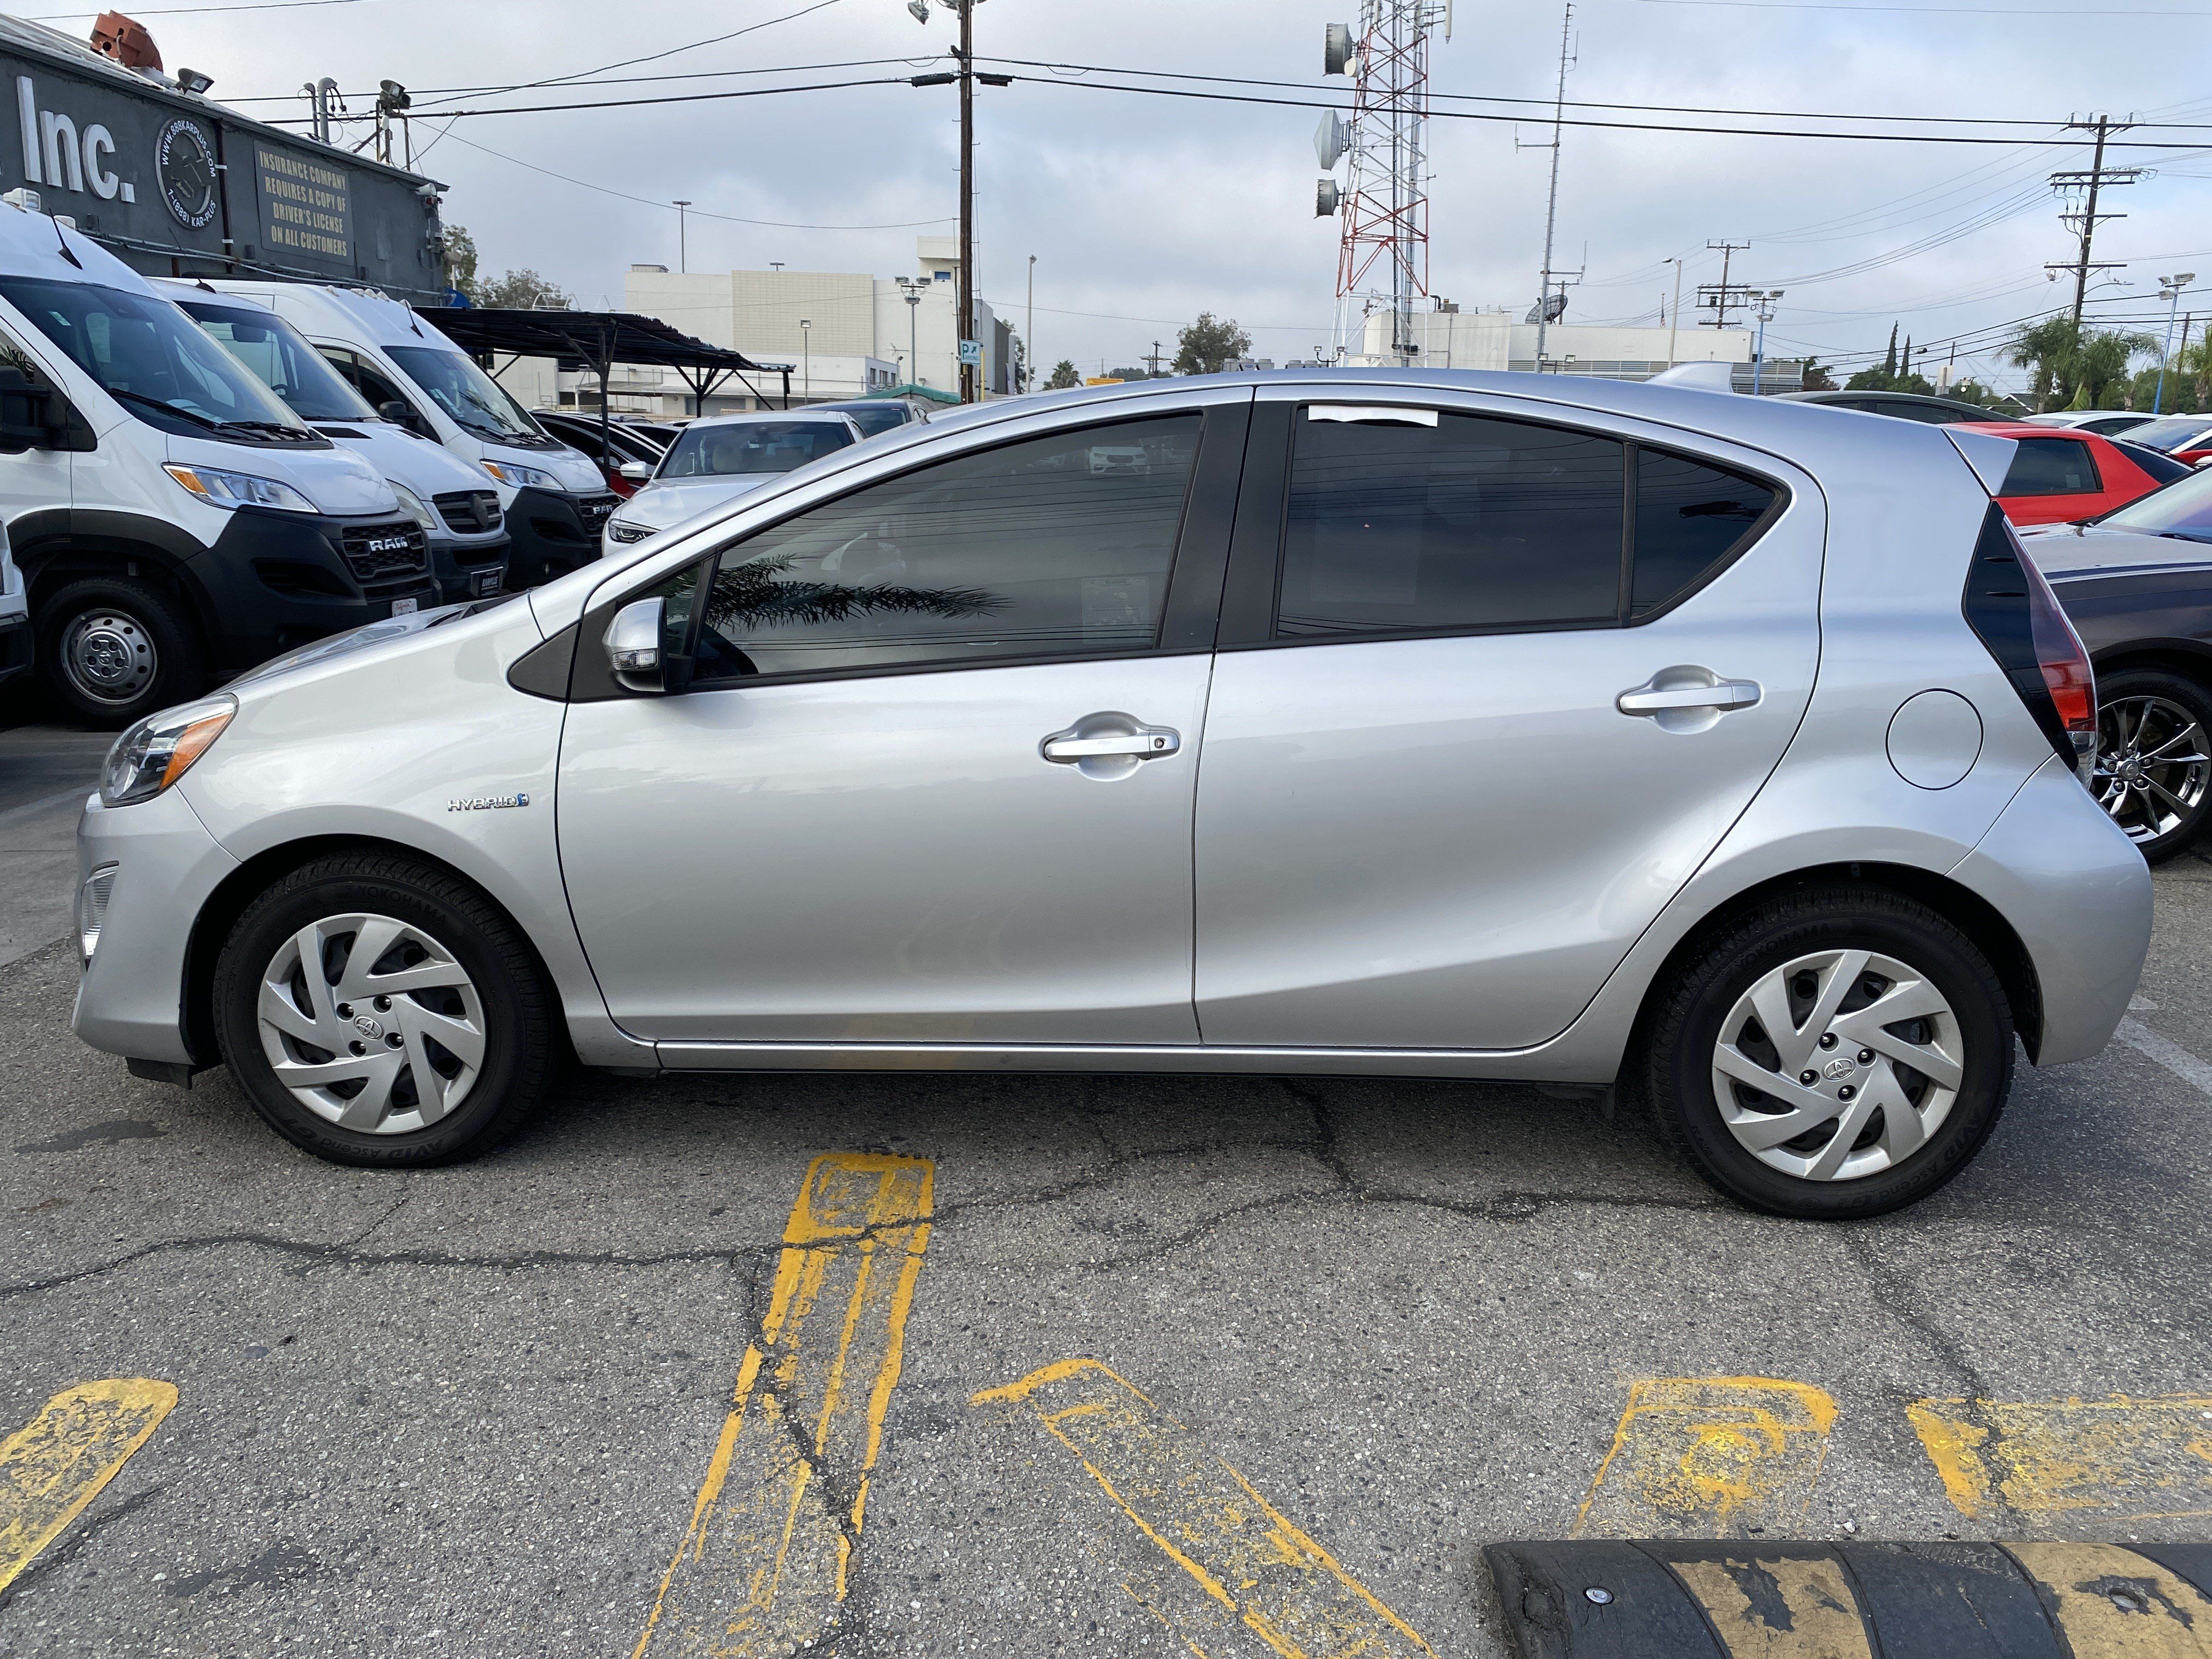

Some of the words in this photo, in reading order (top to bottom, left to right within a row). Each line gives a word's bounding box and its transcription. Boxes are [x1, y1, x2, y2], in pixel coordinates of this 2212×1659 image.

[16, 75, 136, 203] Inc.
[162, 120, 216, 177] WWW.888KARPLUS.COM
[259, 150, 308, 180] INSURANCE
[309, 166, 346, 190] COMPANY
[265, 176, 307, 202] REQUIRES
[308, 188, 314, 204] A
[315, 190, 335, 210] COPY
[337, 196, 346, 212] OF
[273, 202, 311, 227] DRIVER'S
[313, 212, 343, 234] LICENSE
[271, 225, 283, 243] ON
[285, 229, 299, 247] ALL
[300, 232, 347, 257] CUSTOMERS
[369, 537, 408, 551] RAM
[447, 796, 517, 811] HYBRID
[358, 885, 447, 926] YOKOHAMA
[1734, 923, 1831, 971] YOKOHAMA
[320, 1137, 382, 1159] Ascend
